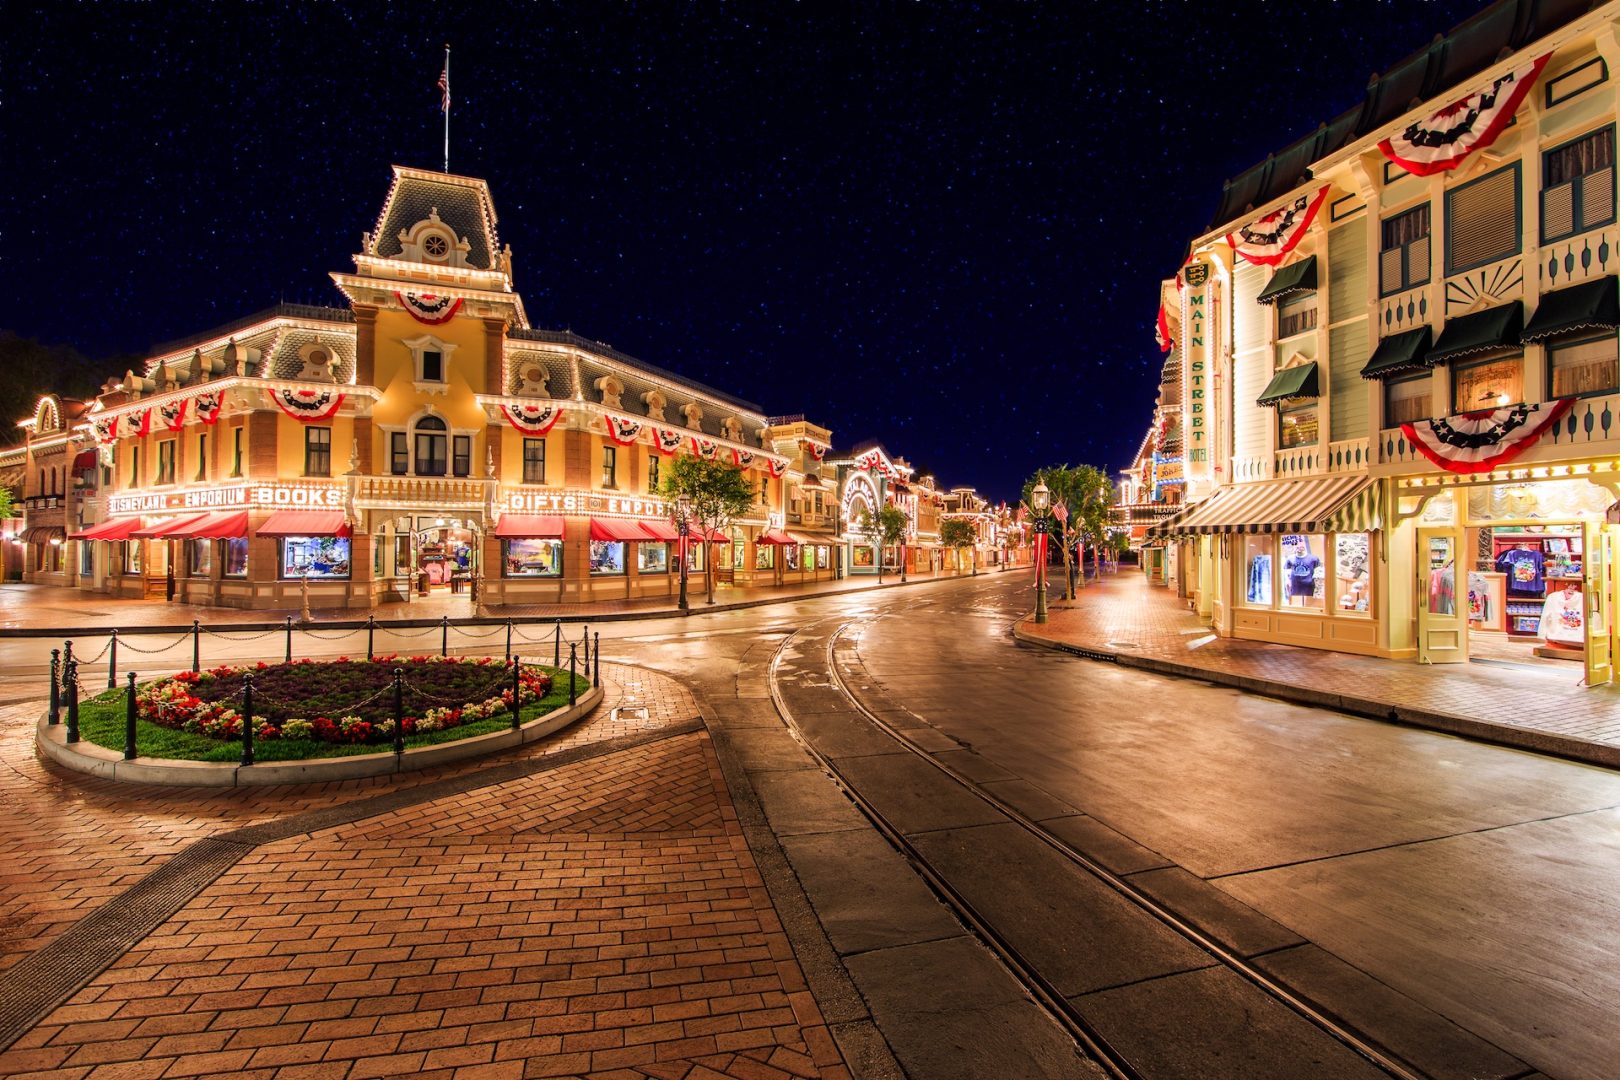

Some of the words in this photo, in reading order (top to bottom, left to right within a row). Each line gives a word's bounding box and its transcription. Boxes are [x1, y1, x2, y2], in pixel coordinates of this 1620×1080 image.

[1190, 294, 1205, 347] MAIN
[1191, 360, 1206, 441] STREET
[1188, 448, 1207, 462] HOTEL
[109, 495, 168, 513] DISNEYLAND
[185, 487, 246, 507] EMPORIUM
[257, 487, 342, 505] BOOKS
[511, 494, 577, 511] GIFTS
